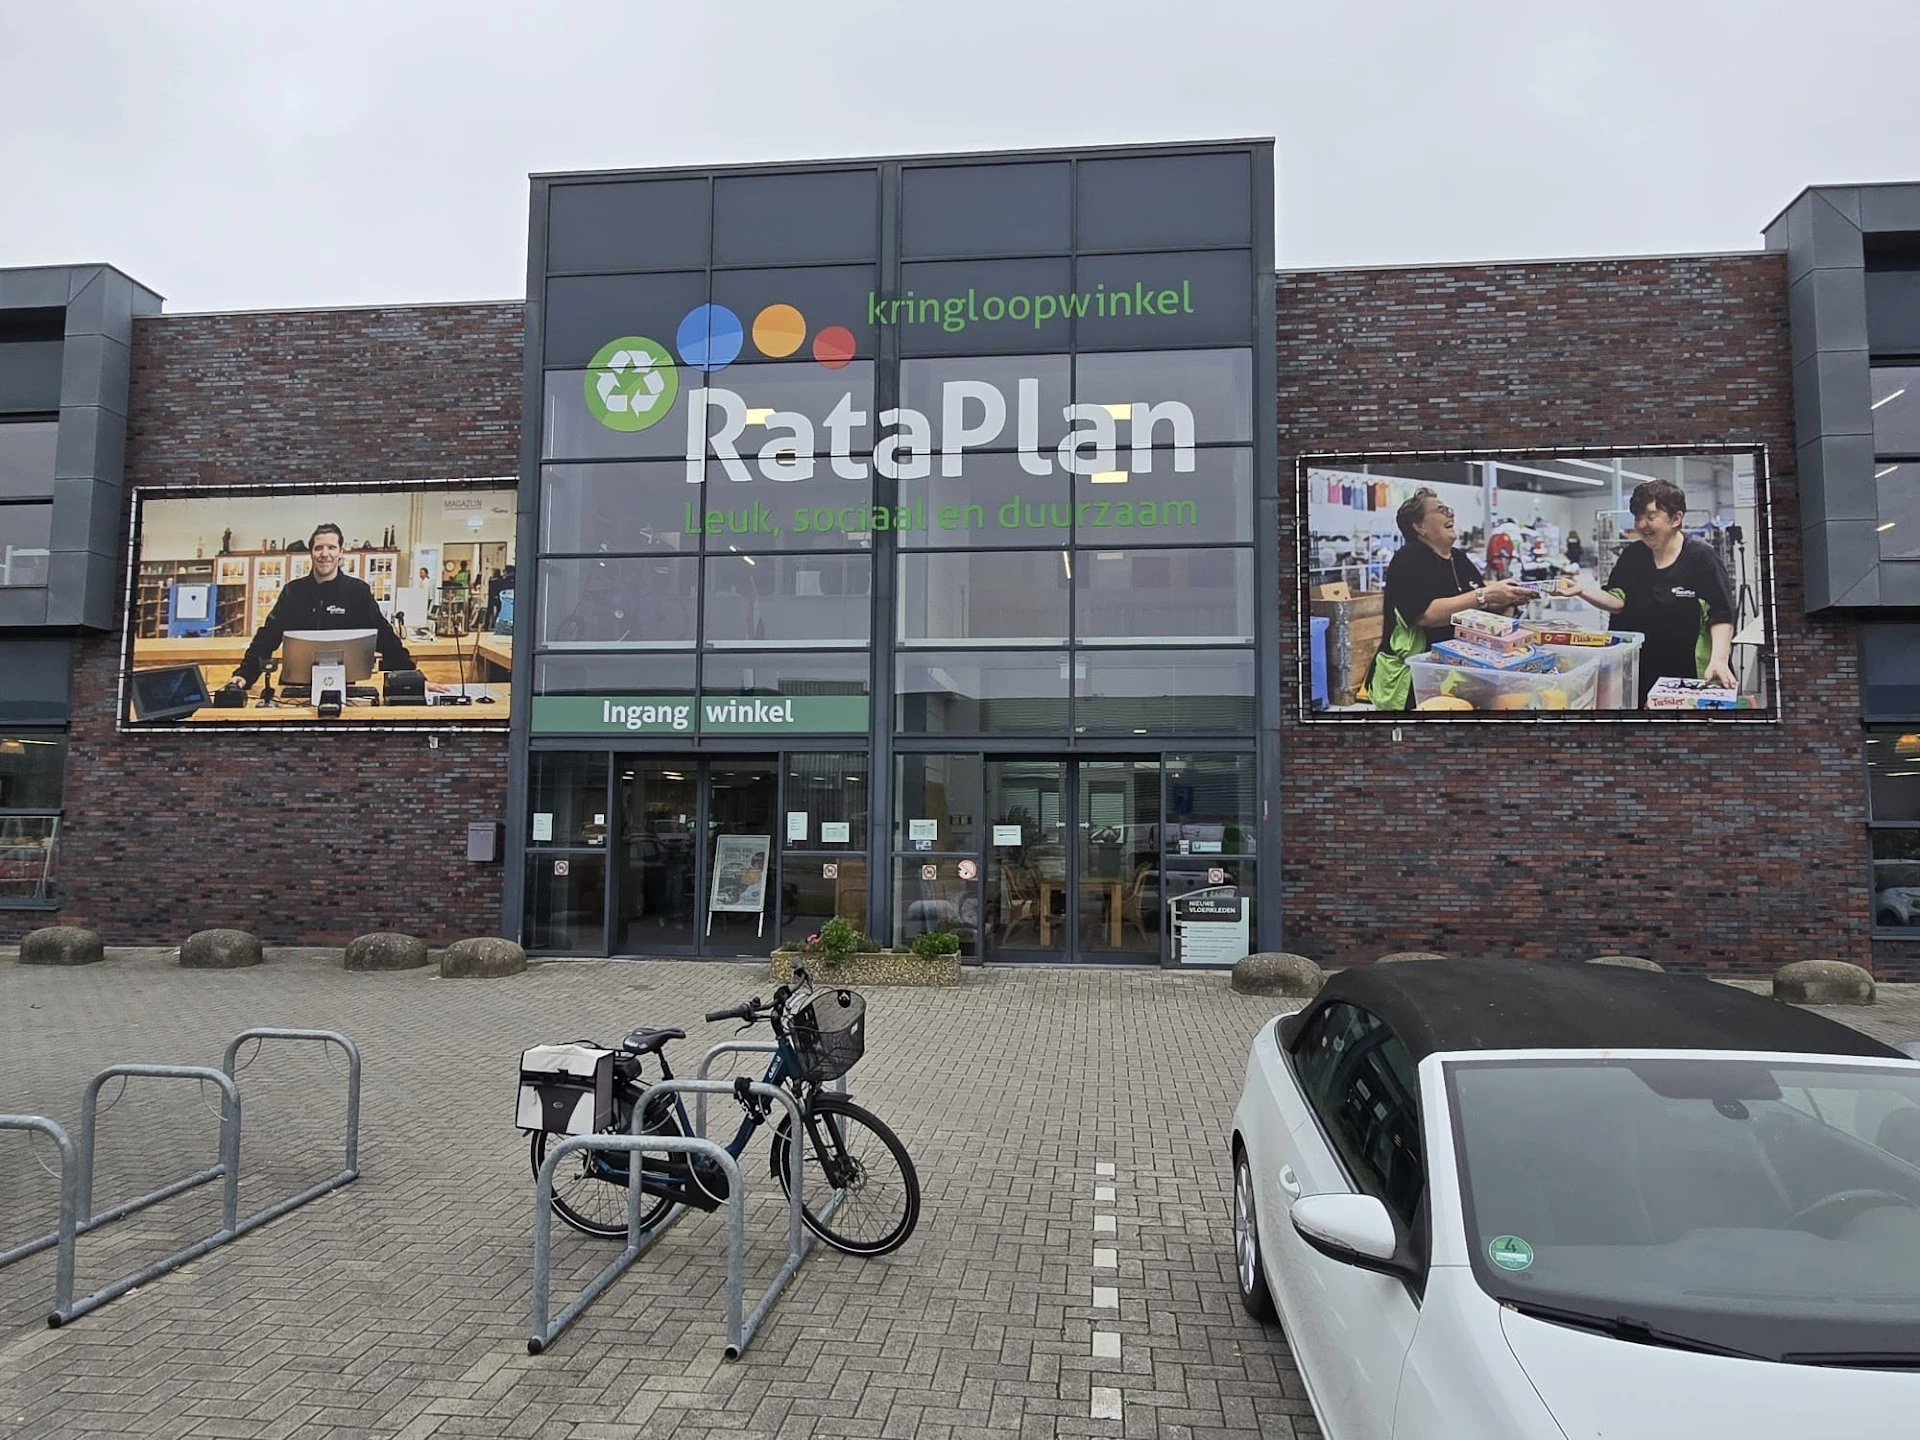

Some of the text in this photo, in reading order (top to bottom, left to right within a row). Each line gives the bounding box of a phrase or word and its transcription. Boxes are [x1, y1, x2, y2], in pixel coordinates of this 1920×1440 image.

[868, 280, 1194, 332] kringloopwinkel
[686, 378, 1196, 483] RataPlan
[683, 495, 1197, 538] Leuk, sociaal en duurzaam
[603, 699, 794, 730] Ingang winkel
[1504, 1237, 1517, 1253] 4
